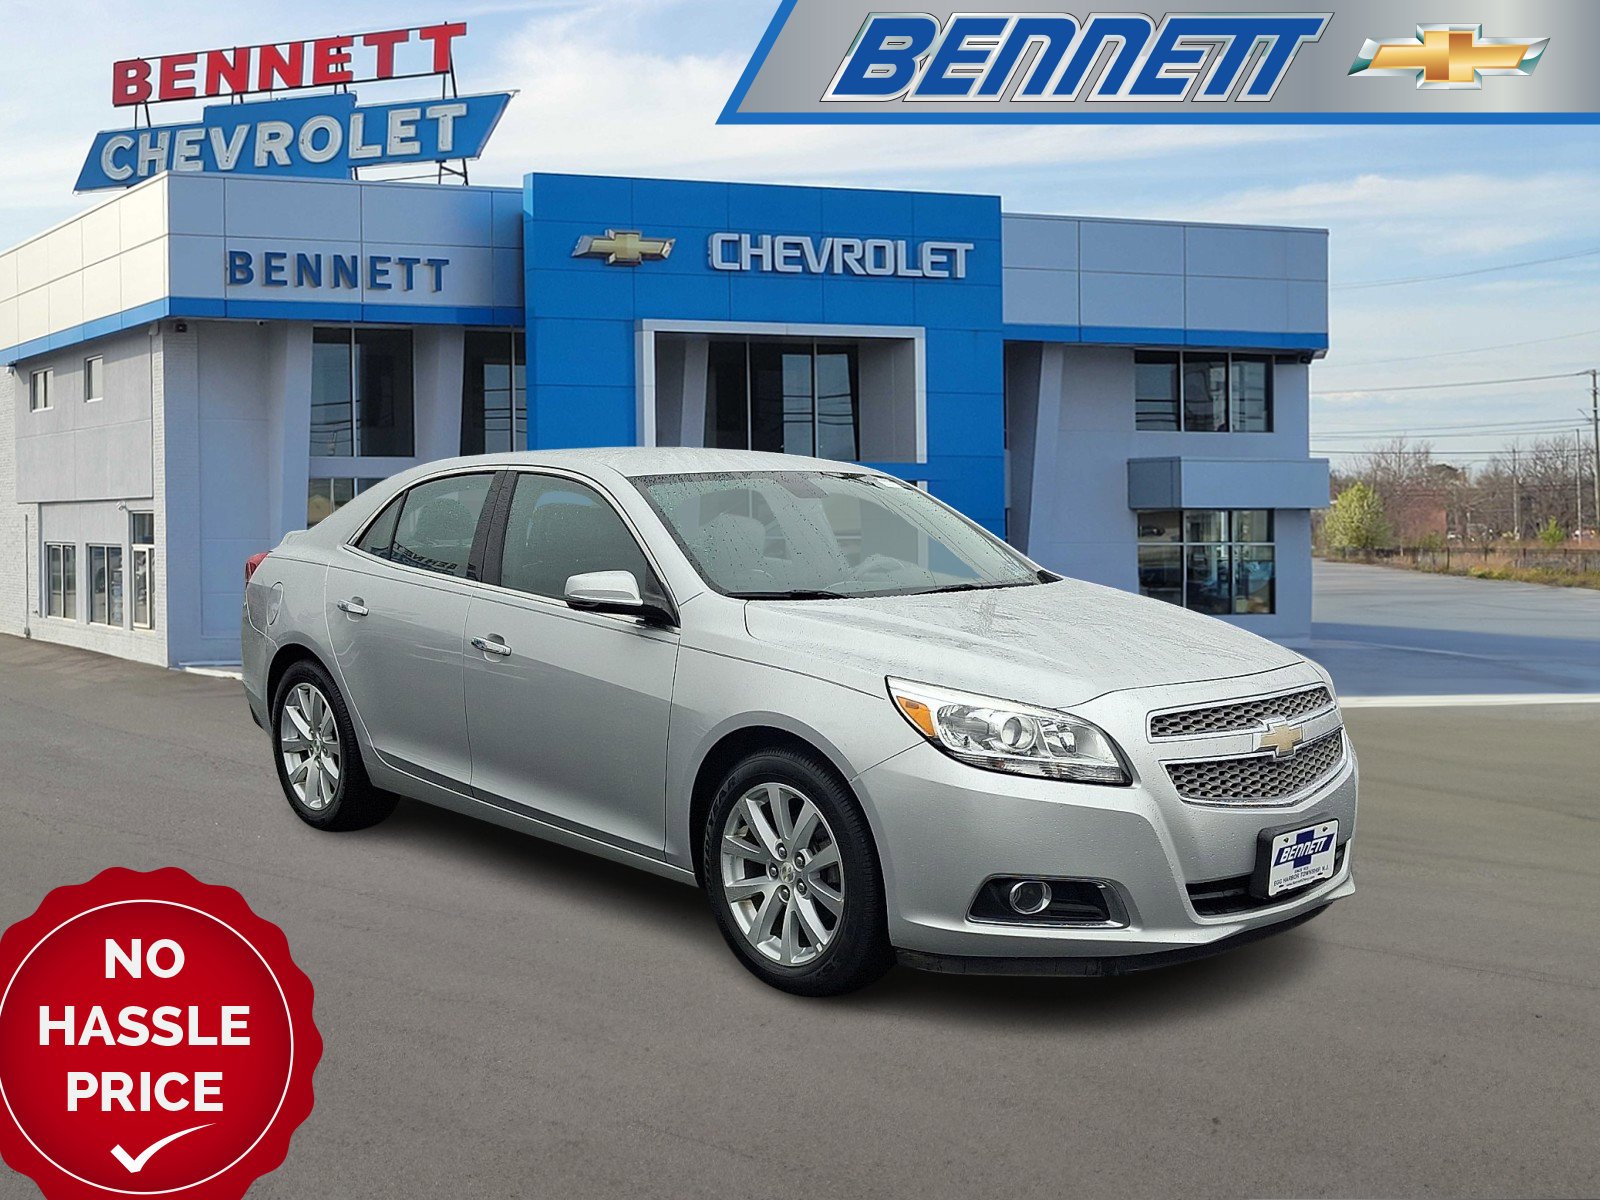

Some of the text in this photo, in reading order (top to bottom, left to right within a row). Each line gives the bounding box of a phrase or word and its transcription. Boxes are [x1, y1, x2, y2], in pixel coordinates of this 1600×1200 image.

[113, 23, 467, 106] BENNETT
[101, 104, 467, 180] CHEVROLET
[227, 250, 450, 292] BENNETT
[708, 232, 974, 278] CHEVROLET
[1280, 837, 1327, 863] BENNETT
